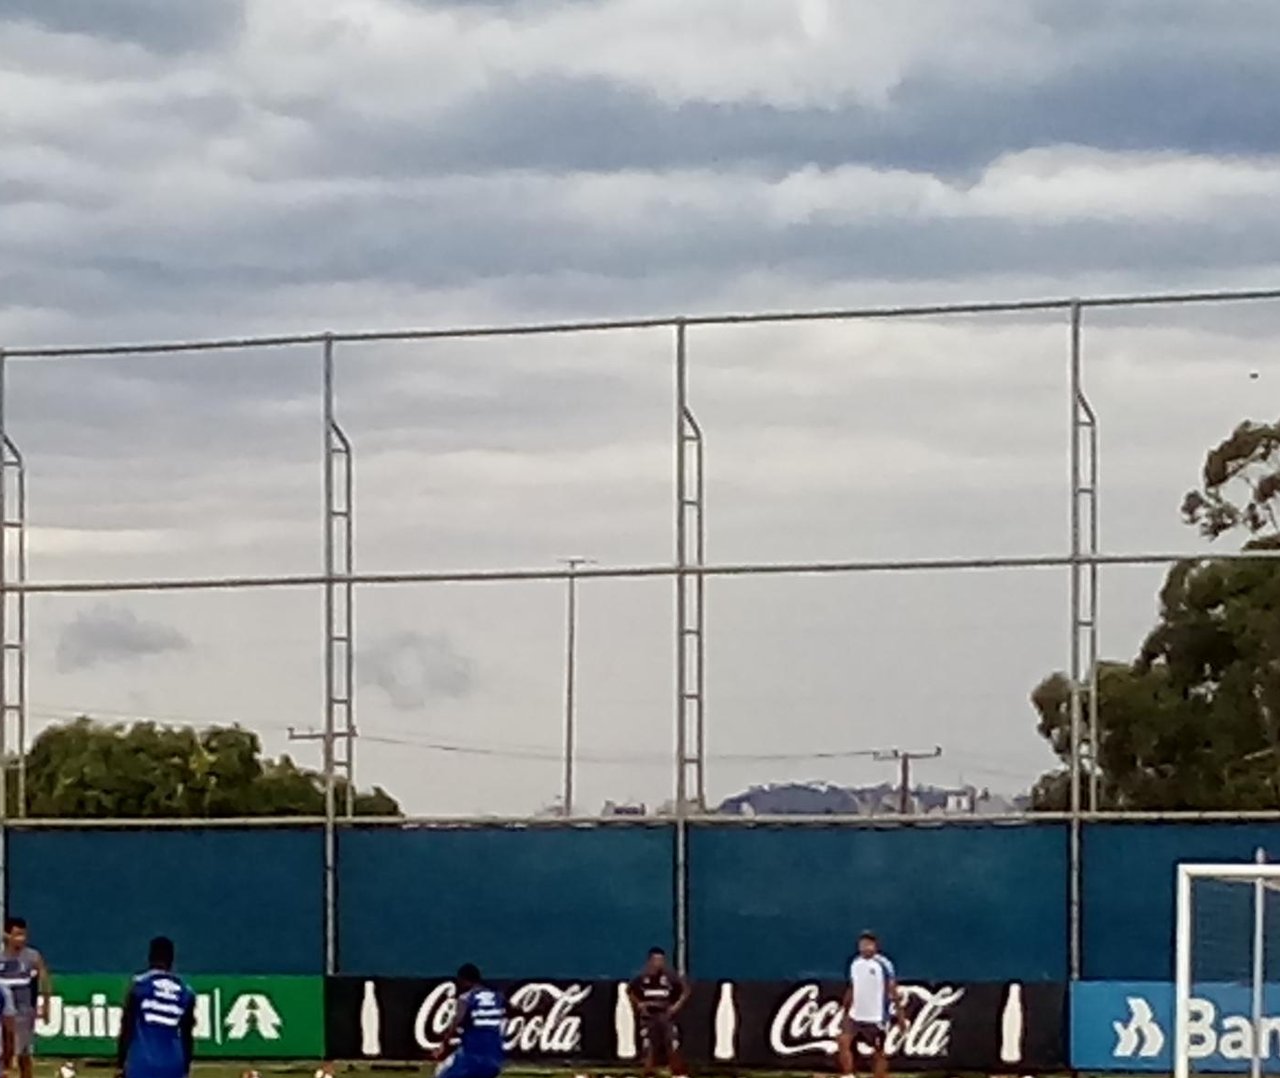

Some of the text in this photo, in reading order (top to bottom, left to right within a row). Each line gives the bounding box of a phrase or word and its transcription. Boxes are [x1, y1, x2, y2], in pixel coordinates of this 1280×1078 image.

[33, 994, 210, 1037] Unid
[414, 981, 593, 1052] CoCola
[770, 983, 966, 1056] Cocola
